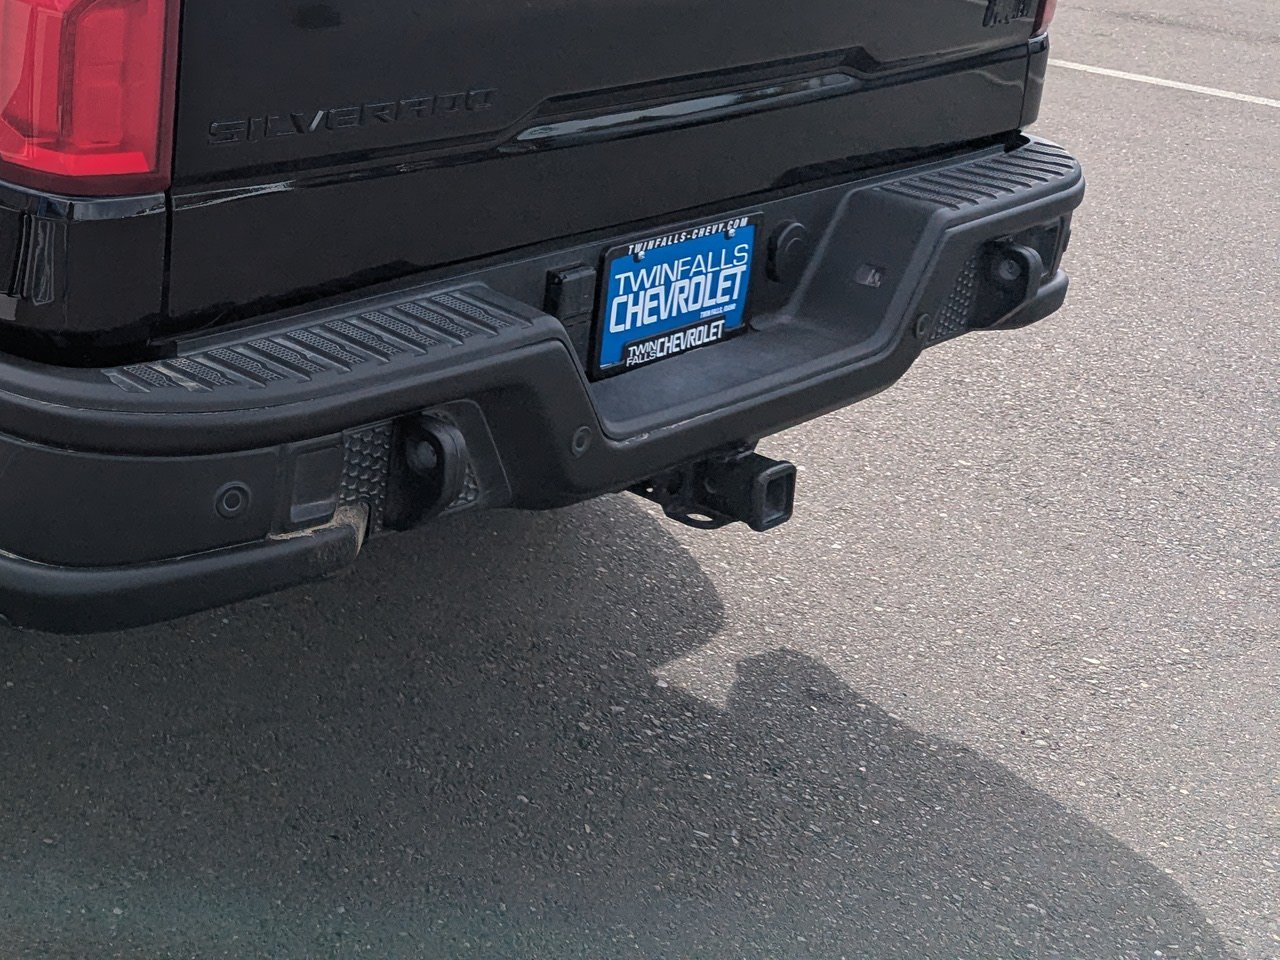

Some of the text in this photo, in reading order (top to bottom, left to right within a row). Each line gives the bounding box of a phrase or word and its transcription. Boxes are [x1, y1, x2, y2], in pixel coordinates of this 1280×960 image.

[207, 87, 499, 145] SILVERADO
[628, 217, 748, 255] TWINFALLS-CHEVY.COM
[614, 243, 749, 295] TWINFALLS
[609, 264, 748, 334] CHEVROLET
[626, 351, 657, 367] FALLS
[628, 319, 726, 358] TWIN CHEVROLET
